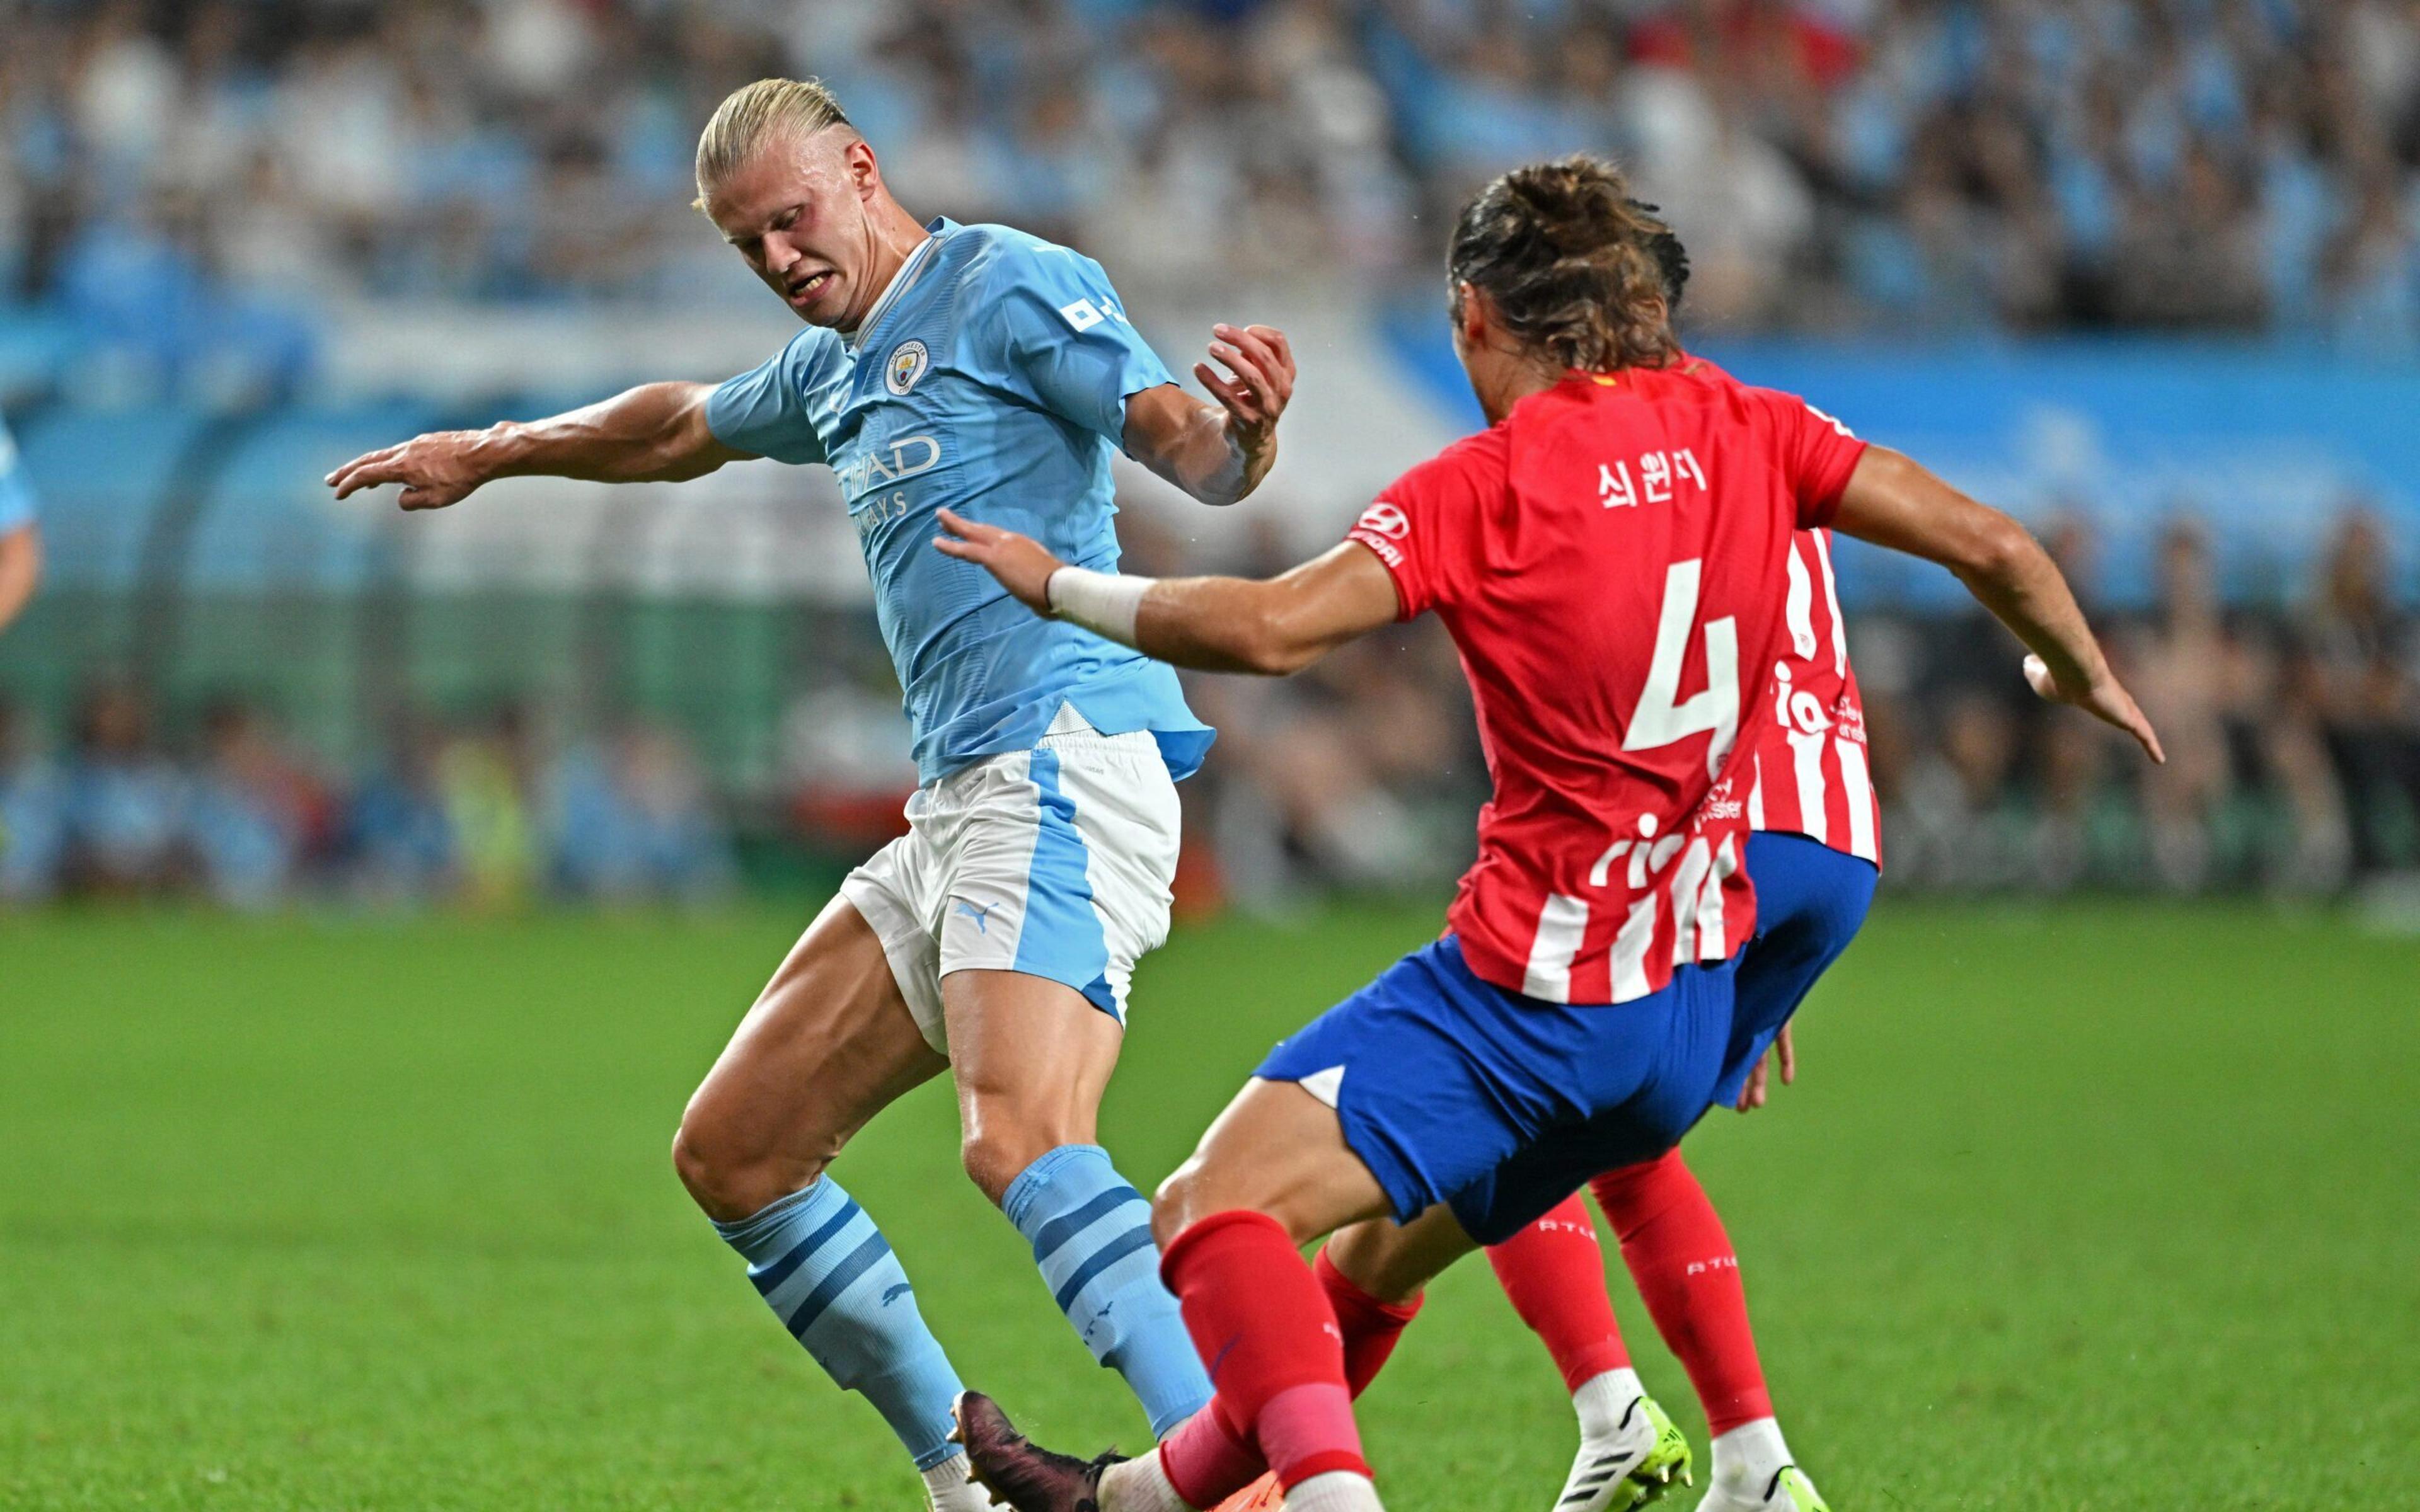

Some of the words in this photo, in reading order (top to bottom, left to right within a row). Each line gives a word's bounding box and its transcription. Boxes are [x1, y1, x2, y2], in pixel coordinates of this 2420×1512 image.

[890, 343, 925, 365] MANCHESTER
[899, 384, 909, 394] CITY
[1620, 557, 1740, 783] 4
[1773, 660, 1836, 735] ia
